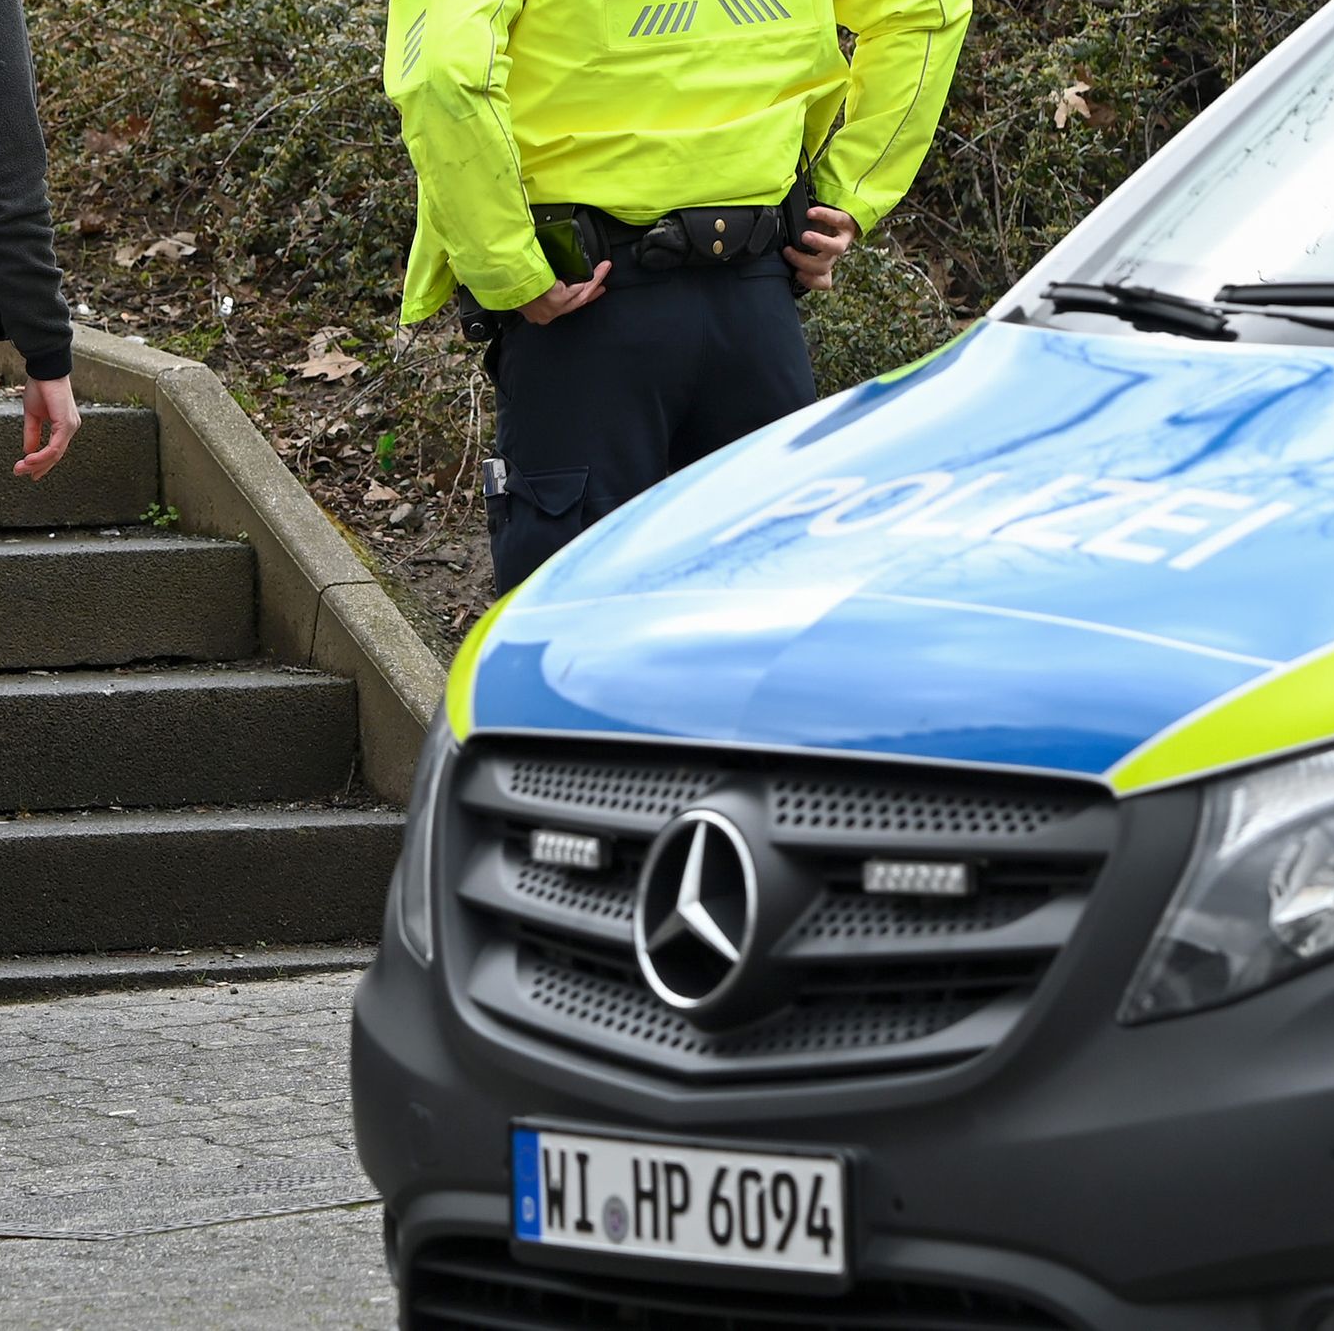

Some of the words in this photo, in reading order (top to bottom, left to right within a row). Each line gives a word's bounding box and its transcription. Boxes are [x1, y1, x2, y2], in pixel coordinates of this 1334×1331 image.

[712, 470, 1294, 571] POLIZEI
[542, 1146, 595, 1233] WI
[632, 1158, 691, 1243] HP
[708, 1166, 835, 1257] 6094
